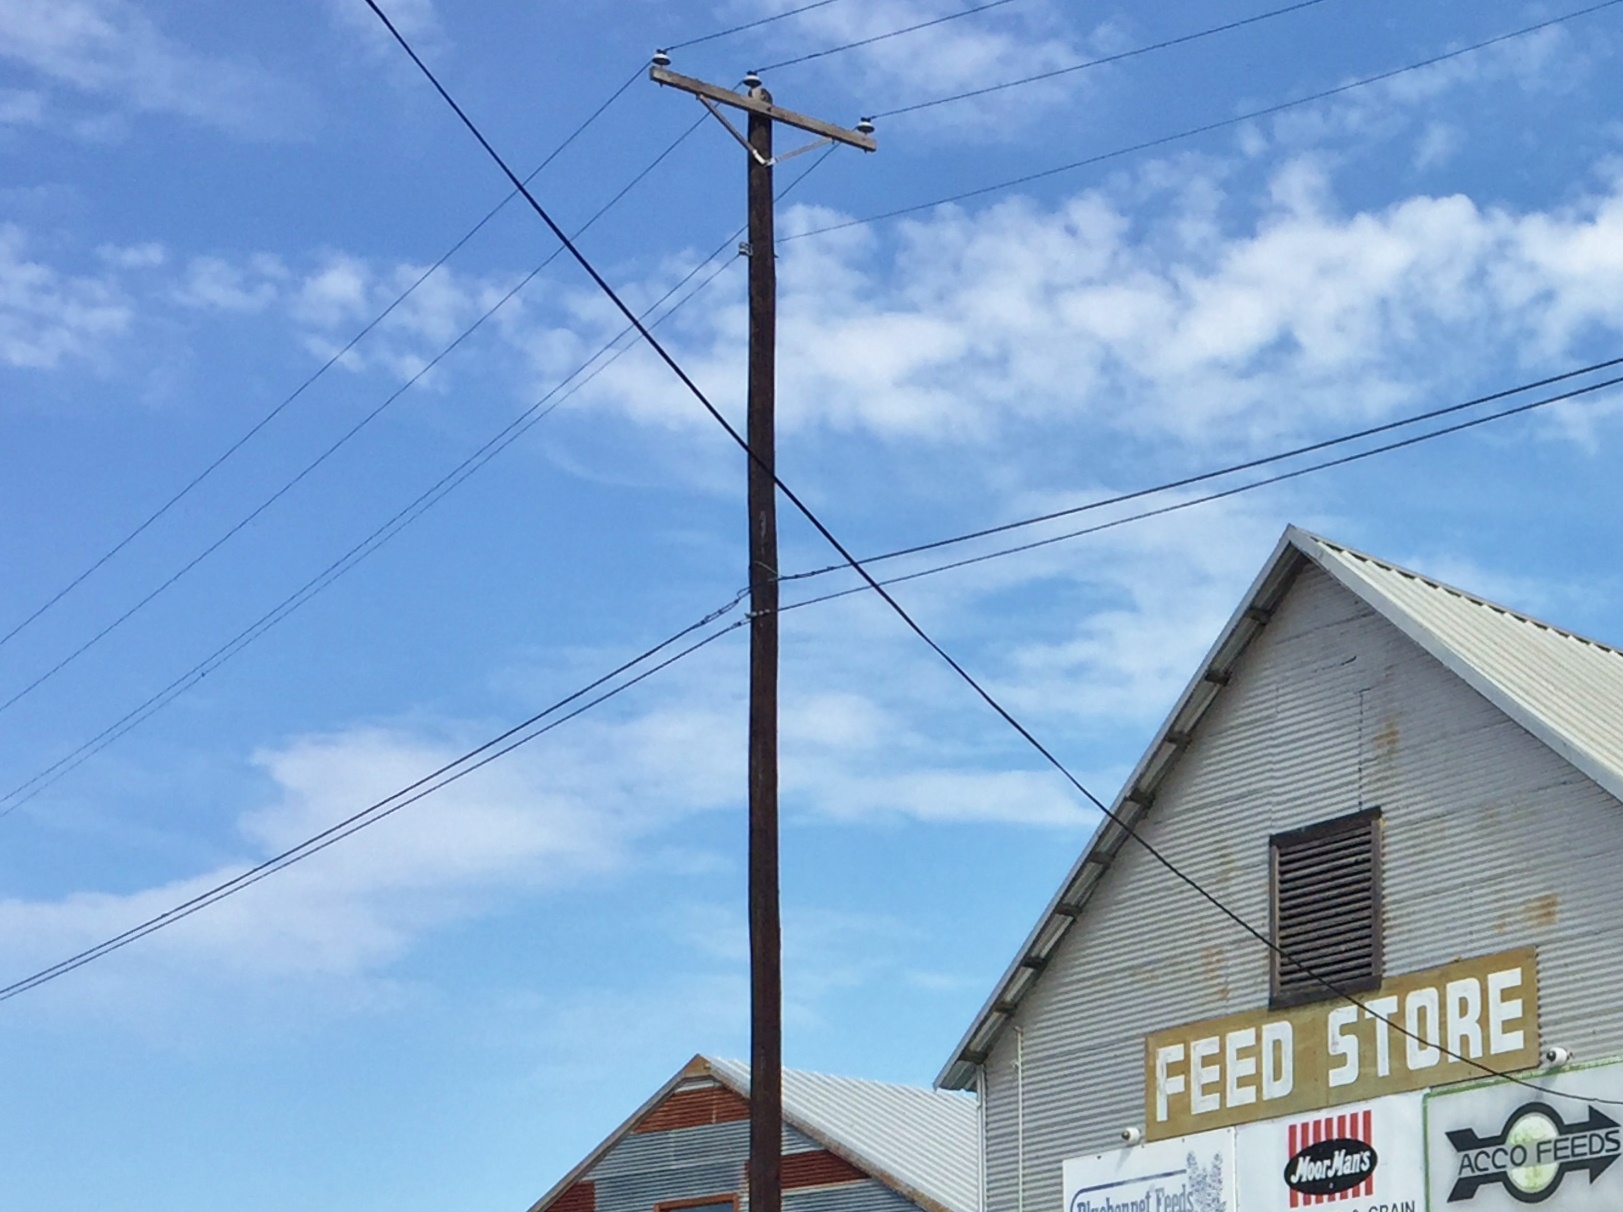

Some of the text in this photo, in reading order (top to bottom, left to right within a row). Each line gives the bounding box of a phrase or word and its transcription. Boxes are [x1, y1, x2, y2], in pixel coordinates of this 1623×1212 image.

[1156, 967, 1525, 1123] FEED STORE
[1458, 1130, 1622, 1176] ACCO FEEDS
